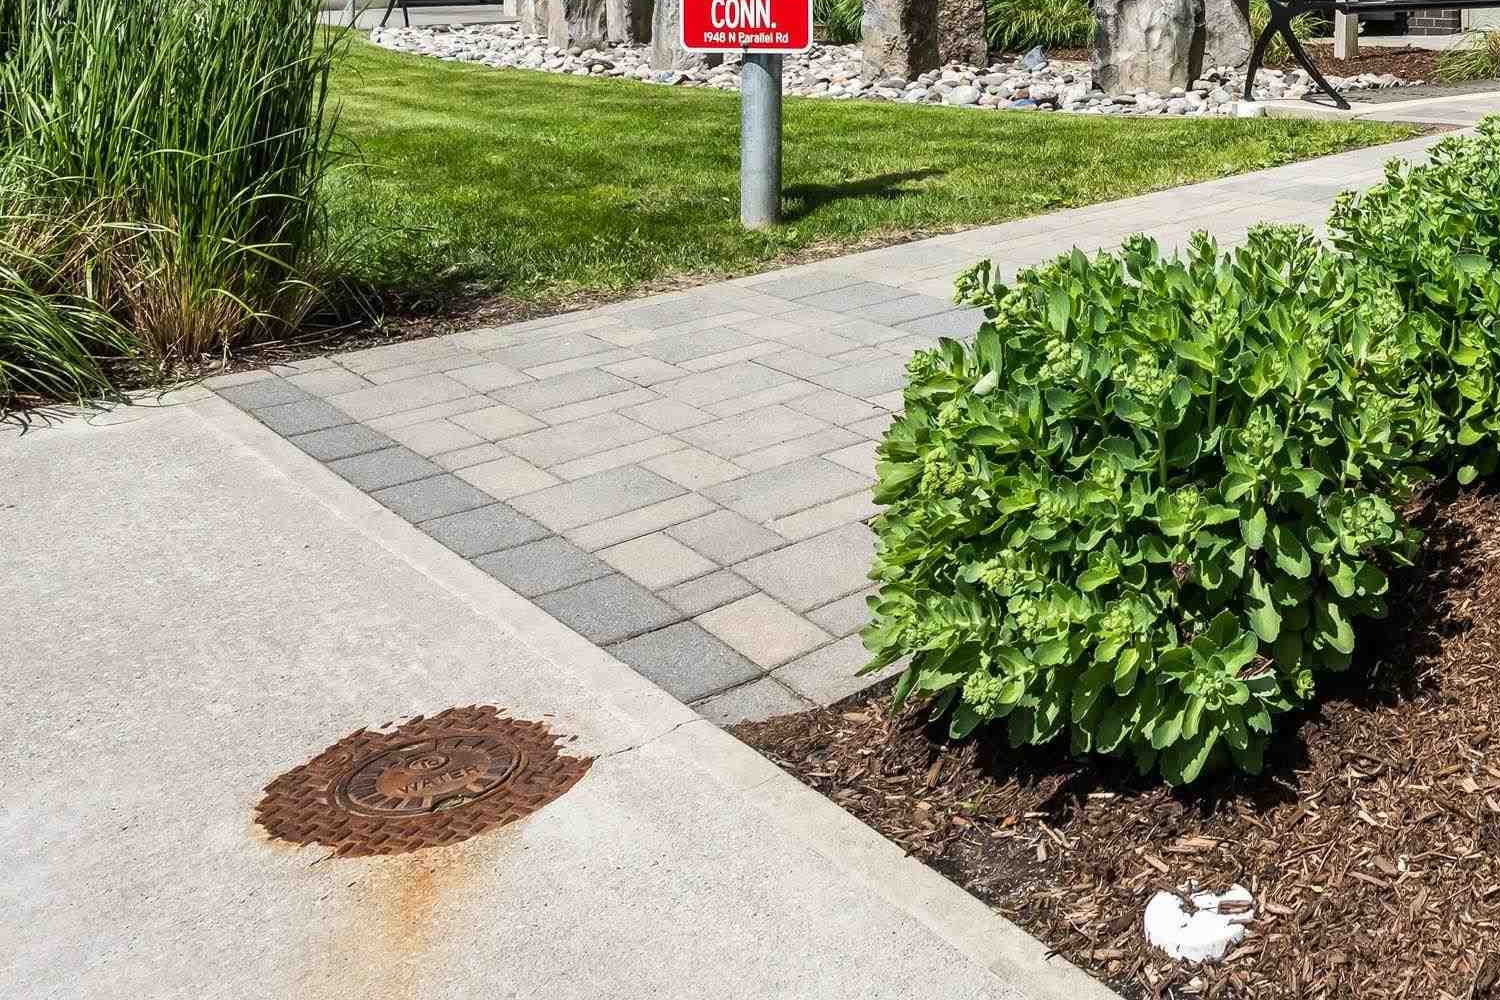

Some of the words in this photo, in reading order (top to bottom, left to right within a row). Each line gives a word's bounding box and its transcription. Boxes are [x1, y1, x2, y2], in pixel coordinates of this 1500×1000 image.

[703, 31, 726, 43] 1948
[729, 31, 736, 43] N
[739, 31, 773, 44] Parallel
[776, 31, 789, 43] Rd
